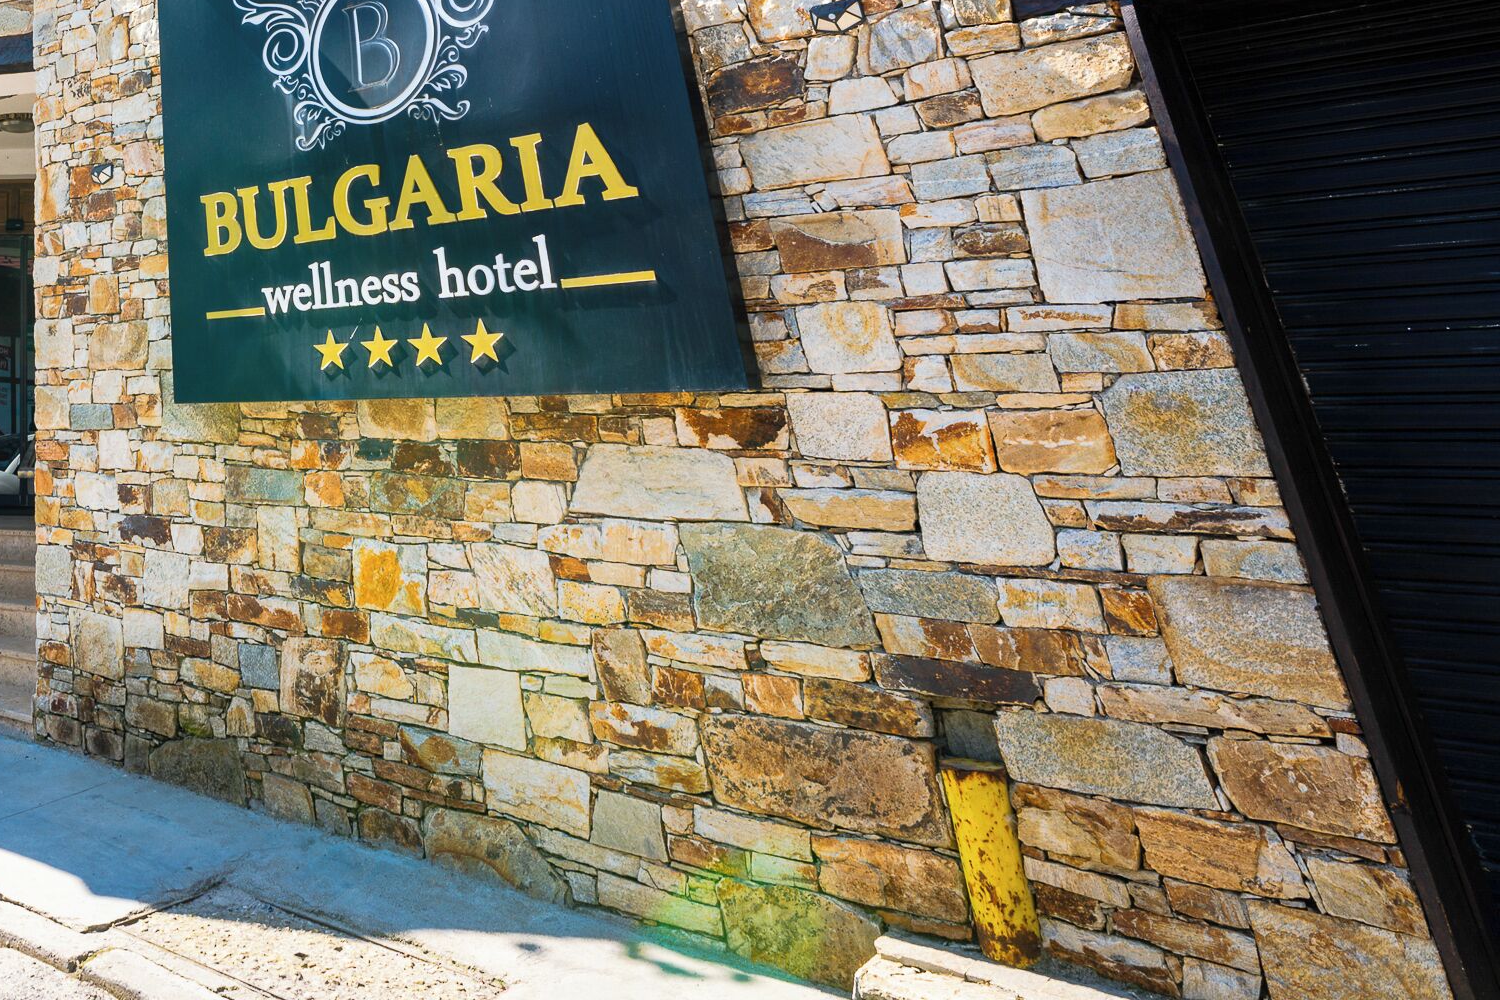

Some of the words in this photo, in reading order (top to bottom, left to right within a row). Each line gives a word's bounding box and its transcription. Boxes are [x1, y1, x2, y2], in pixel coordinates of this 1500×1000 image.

[200, 122, 639, 257] BULGARIA
[261, 260, 421, 315] wellness
[432, 234, 557, 296] hotel
